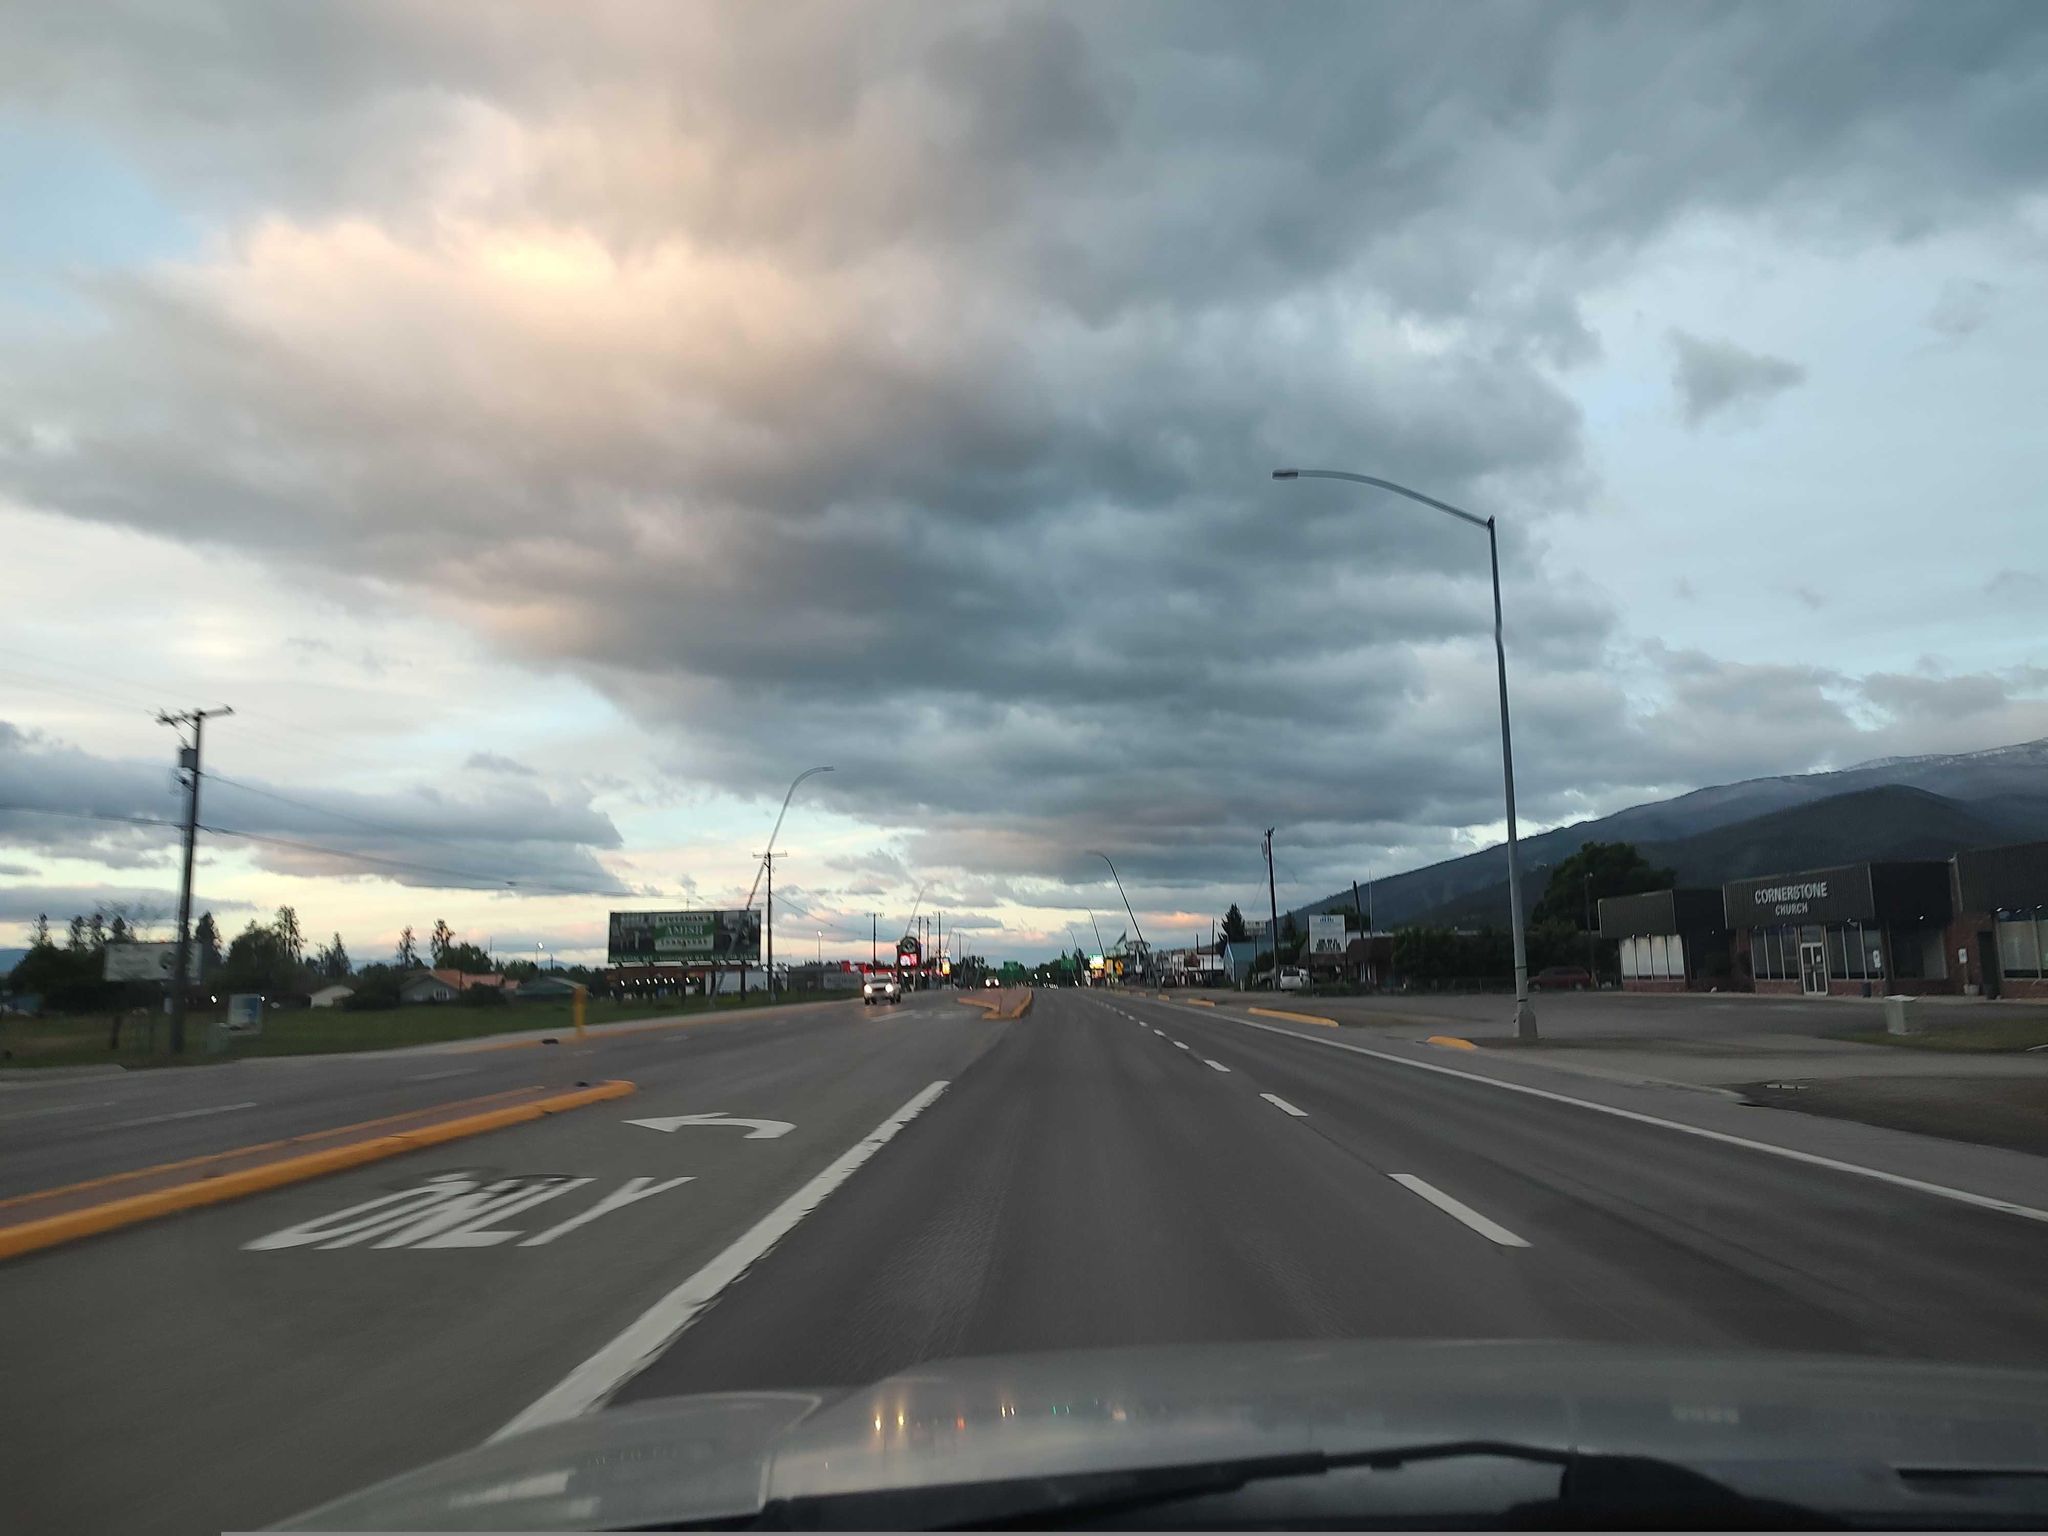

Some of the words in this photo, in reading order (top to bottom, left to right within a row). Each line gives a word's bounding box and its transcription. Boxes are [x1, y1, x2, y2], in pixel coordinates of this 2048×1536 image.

[1755, 882, 1827, 904] CORNERSTONE
[1775, 903, 1808, 916] CHURCH
[241, 1174, 697, 1251] ONLY
